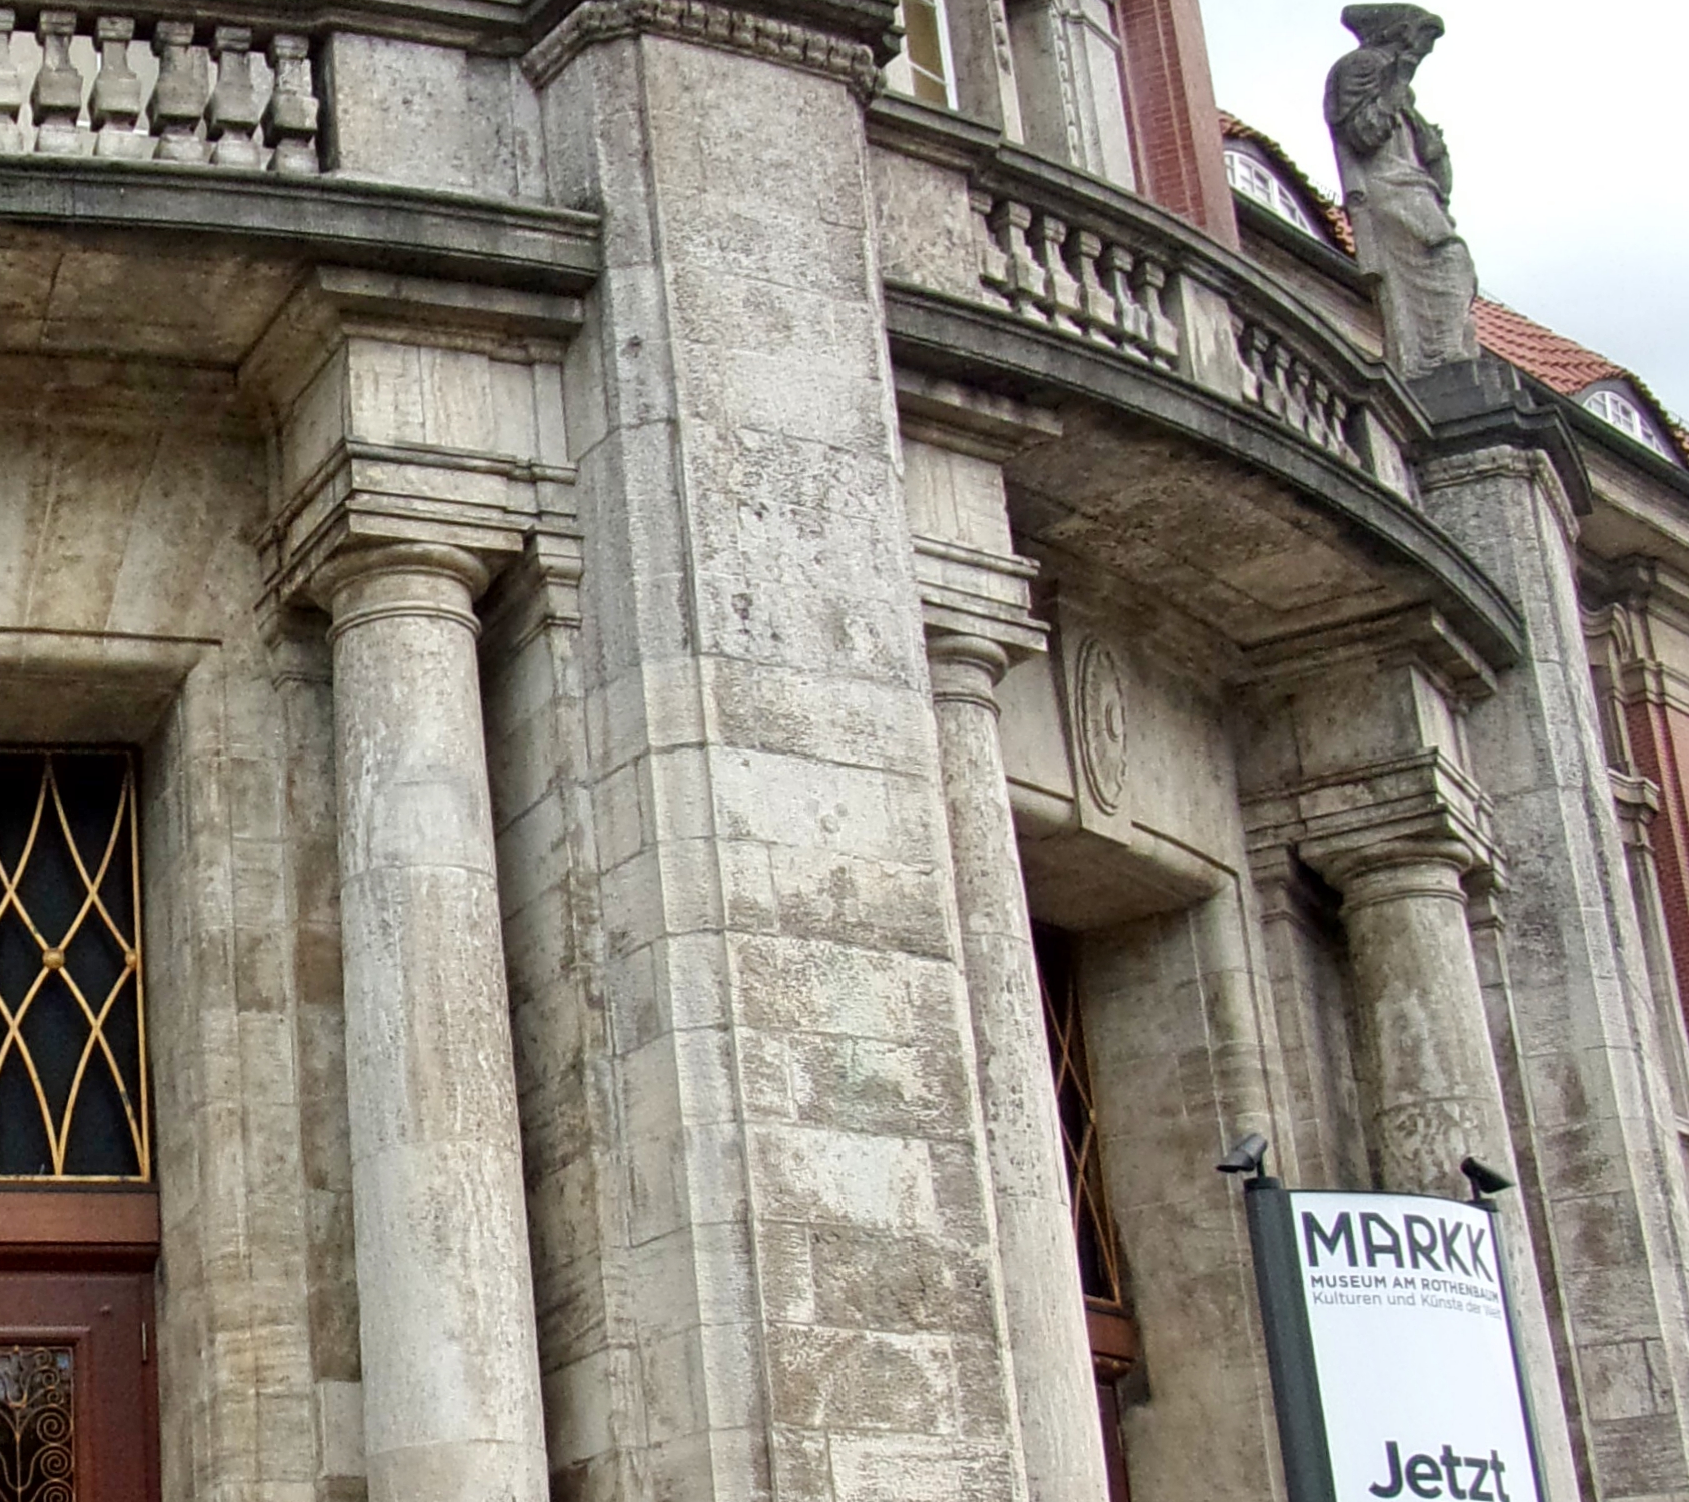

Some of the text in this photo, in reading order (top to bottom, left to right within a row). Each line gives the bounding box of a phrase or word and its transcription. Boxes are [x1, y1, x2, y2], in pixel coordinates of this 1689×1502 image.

[1301, 1211, 1495, 1283] MARKK
[1311, 1275, 1500, 1303] MUSEUM AM ROTHENBAUM
[1312, 1291, 1382, 1306] Kulturen
[1387, 1292, 1416, 1306] und
[1420, 1293, 1463, 1312] Künste
[1465, 1300, 1481, 1314] der
